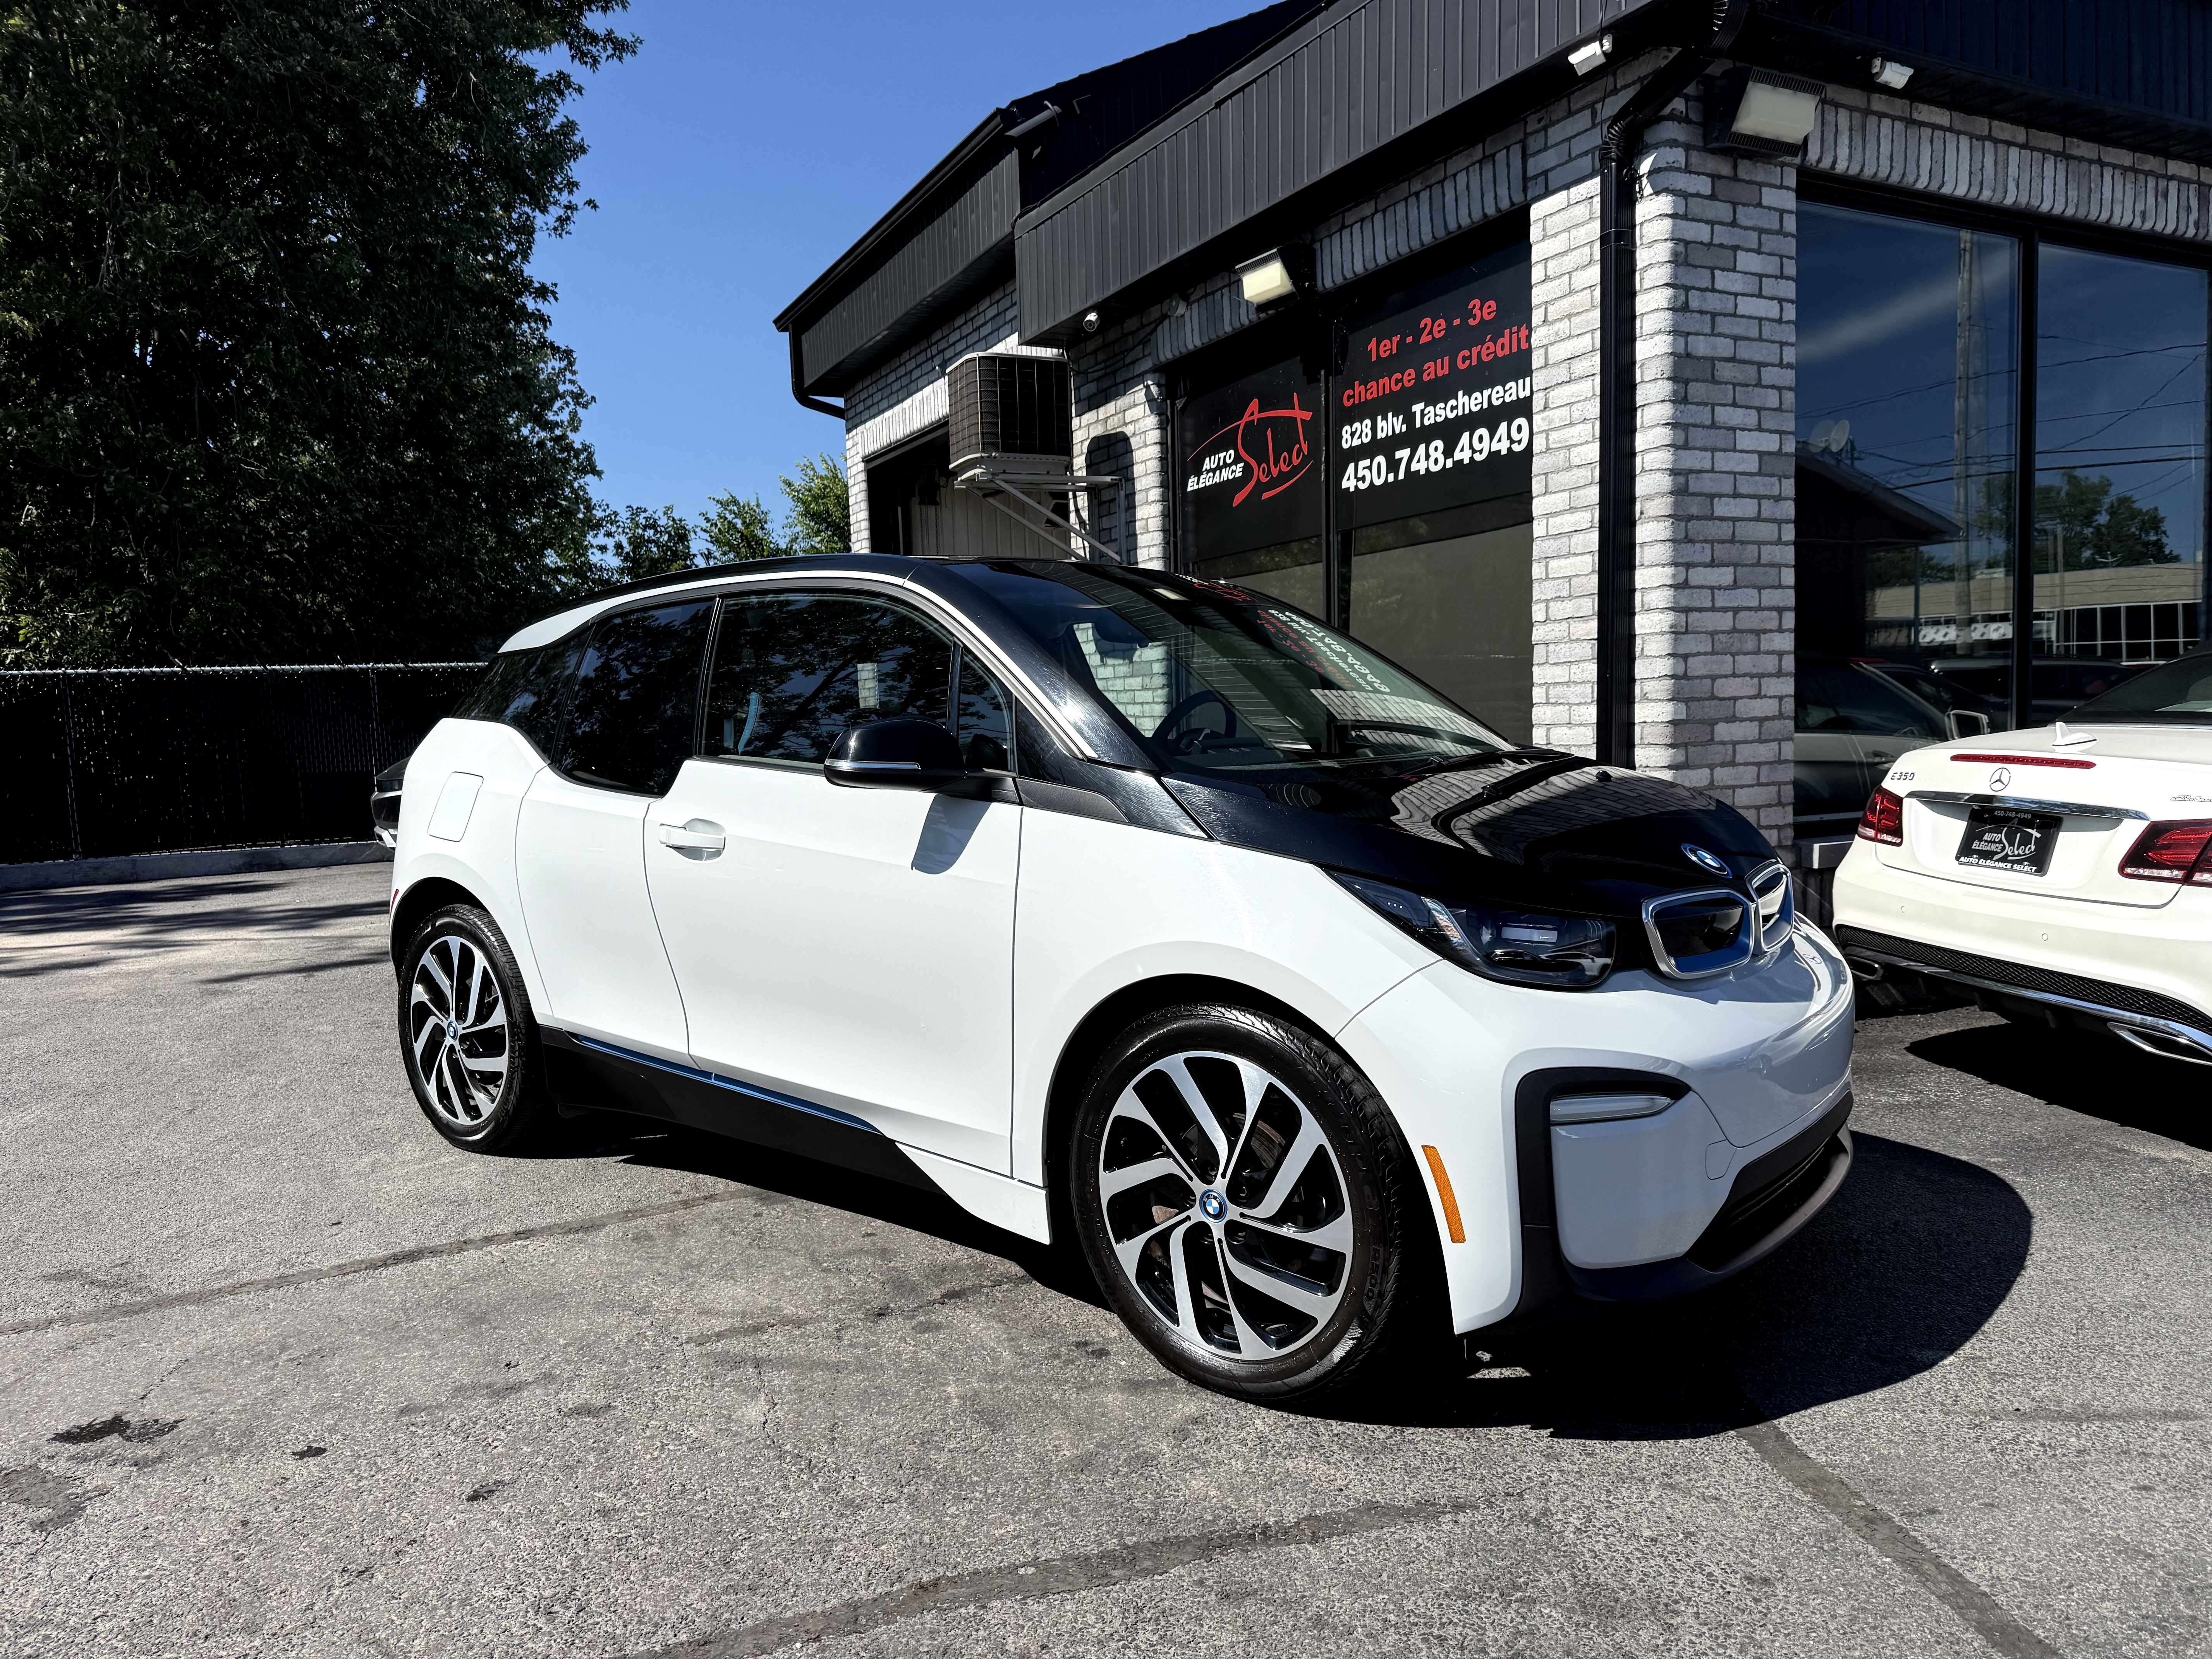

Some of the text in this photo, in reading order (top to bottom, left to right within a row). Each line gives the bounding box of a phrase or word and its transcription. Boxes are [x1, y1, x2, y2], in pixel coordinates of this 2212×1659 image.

[1367, 334, 1400, 362] 1er
[1419, 317, 1446, 344] 2e
[1468, 299, 1497, 326] 3e
[1343, 324, 1529, 407] chance au crédit
[1341, 376, 1531, 449] 828 blv. Taschereau
[1202, 448, 1235, 471] AUTO
[1232, 392, 1313, 507] Select
[1341, 417, 1530, 492] 450.748.4949
[1187, 462, 1244, 492] ÉLÉGANCE
[1891, 772, 1915, 781] E350
[1994, 810, 2032, 819] 450-748-4949
[1971, 839, 2004, 852] ÉLÉGANCE
[1983, 833, 2001, 842] AUTO
[1978, 858, 2012, 869] ÉLÉGANCE
[2013, 863, 2037, 872] SELECT
